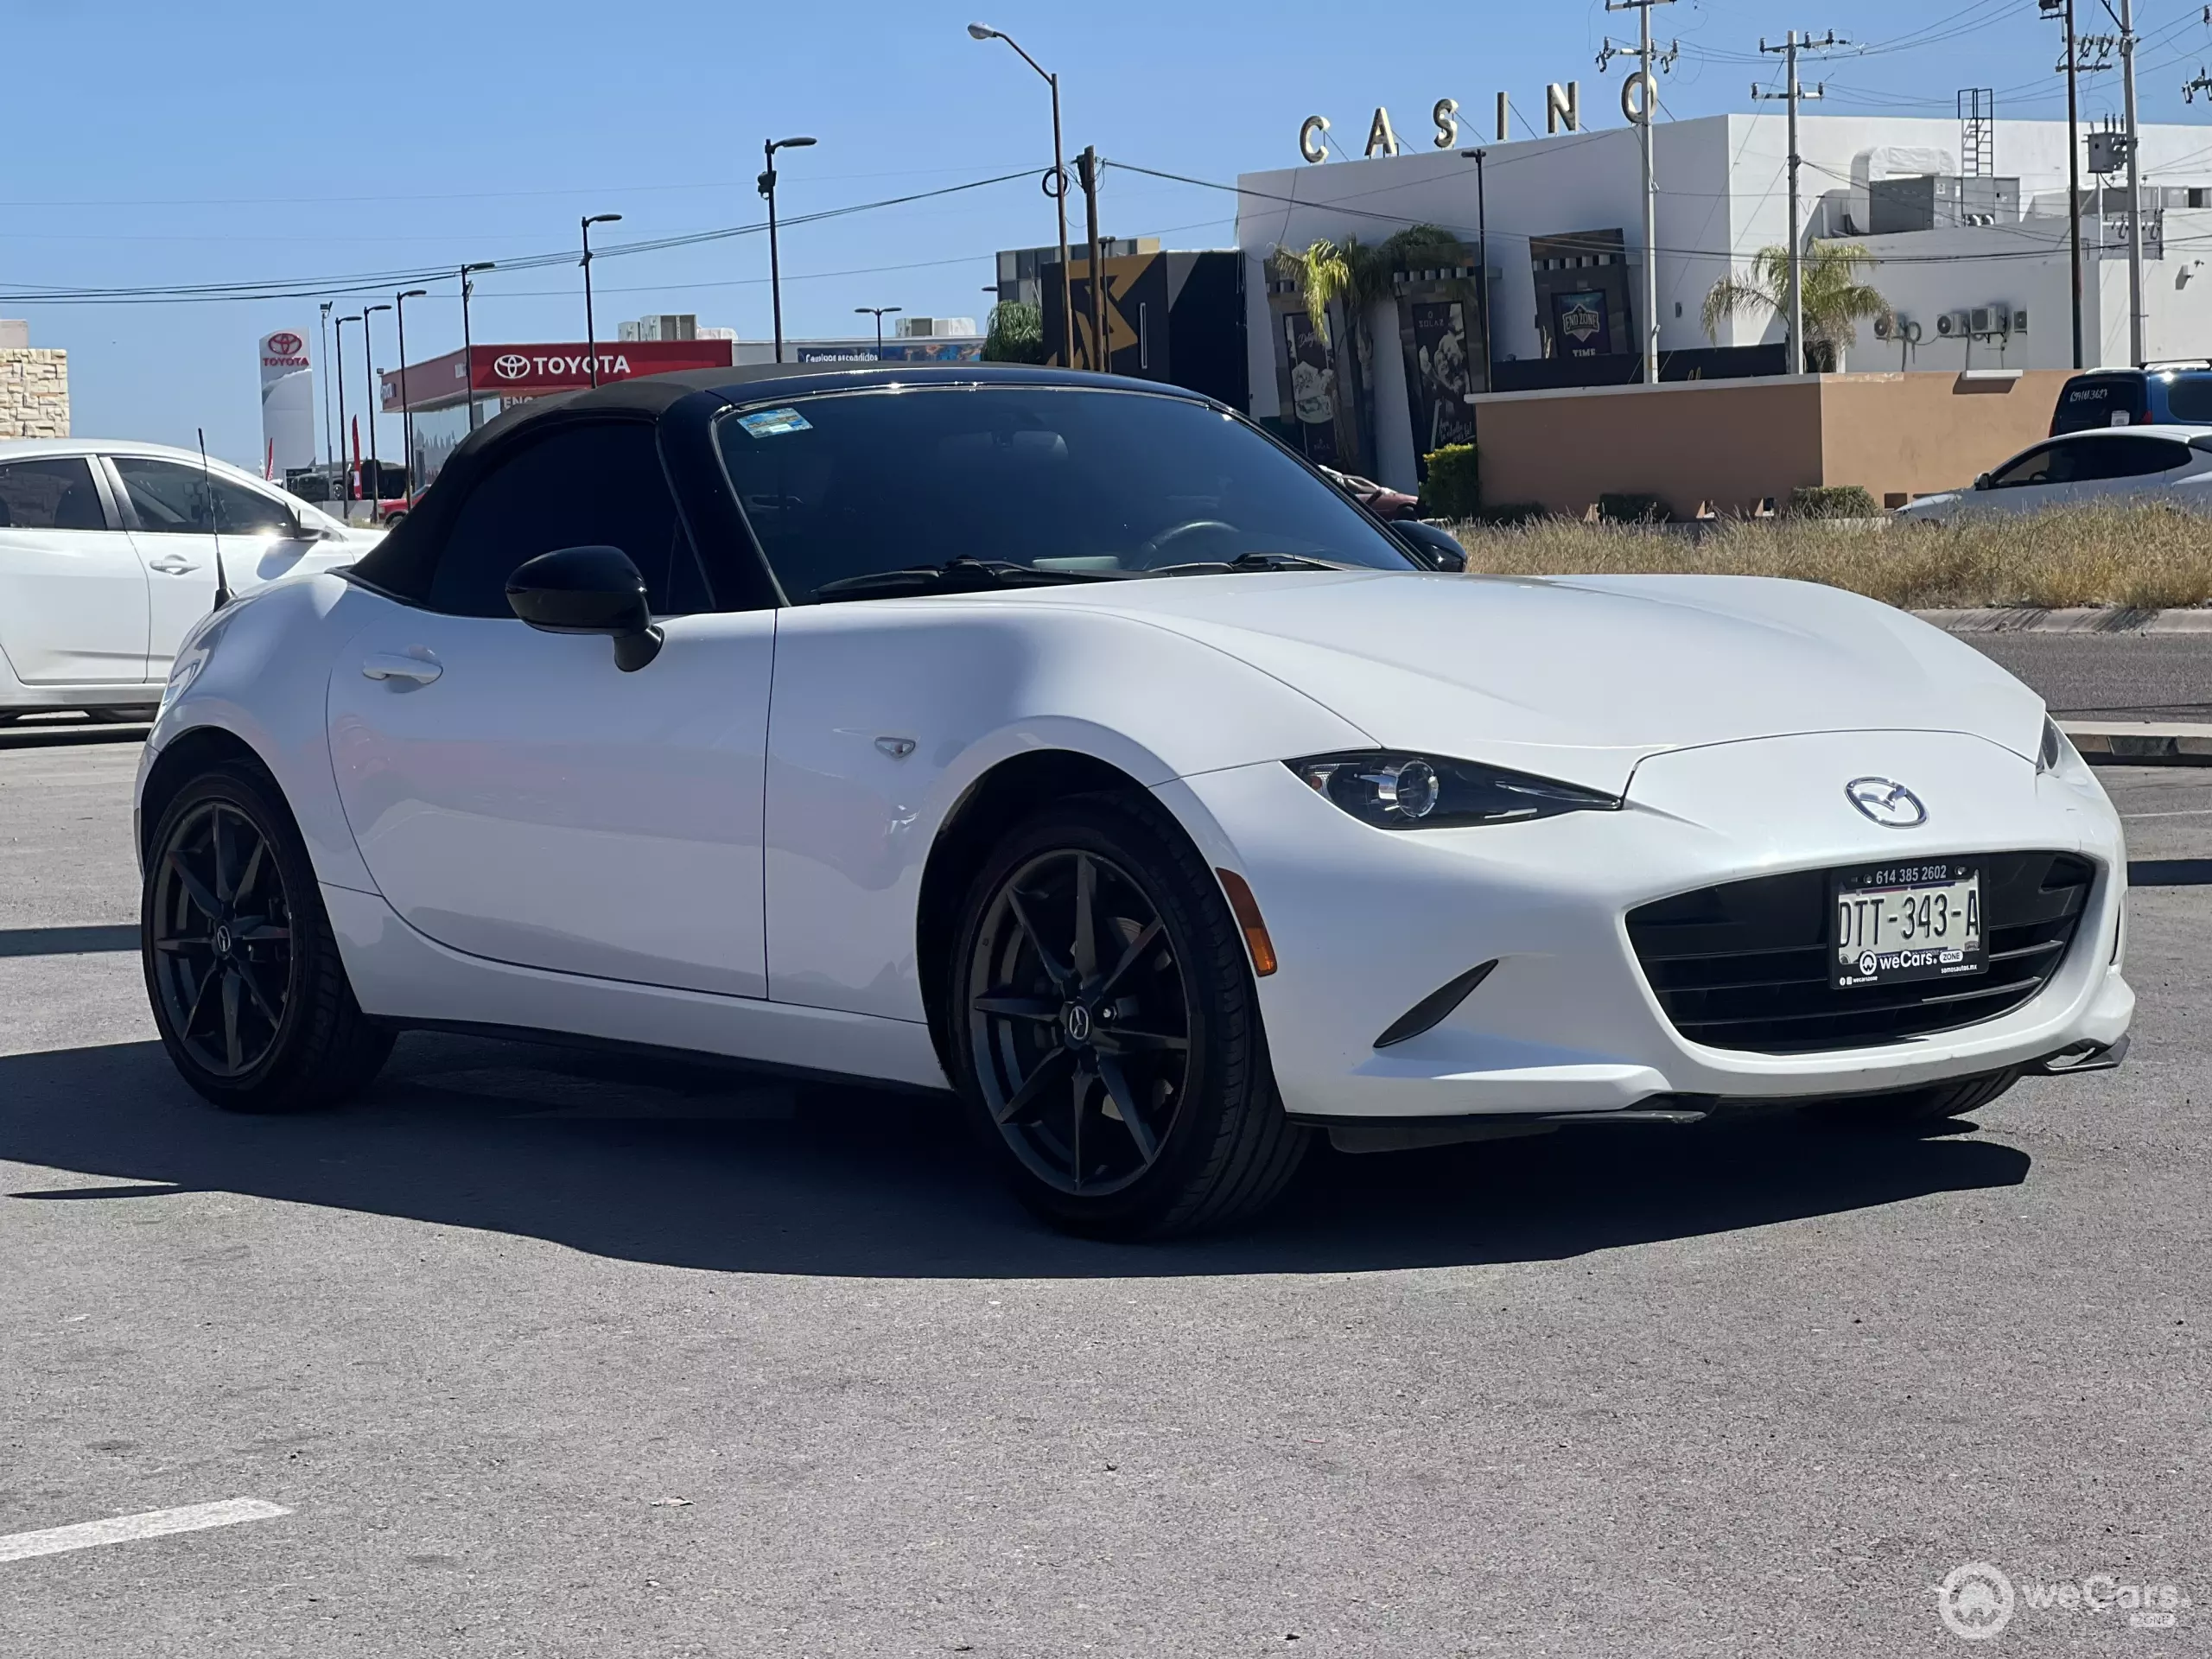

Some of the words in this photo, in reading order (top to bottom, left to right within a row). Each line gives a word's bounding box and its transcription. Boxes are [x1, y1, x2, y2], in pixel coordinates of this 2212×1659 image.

[1300, 71, 1657, 163] CASINO
[1565, 315, 1579, 330] END
[1580, 313, 1598, 328] ZONE
[263, 357, 309, 366] TOYOTA
[533, 355, 631, 375] TOYOTA
[1876, 870, 1896, 885] 614
[1899, 868, 1919, 882] 385
[1922, 865, 1947, 881] 2602
[1839, 889, 1979, 948] DTT-343-A
[1942, 951, 1961, 961] ZONE
